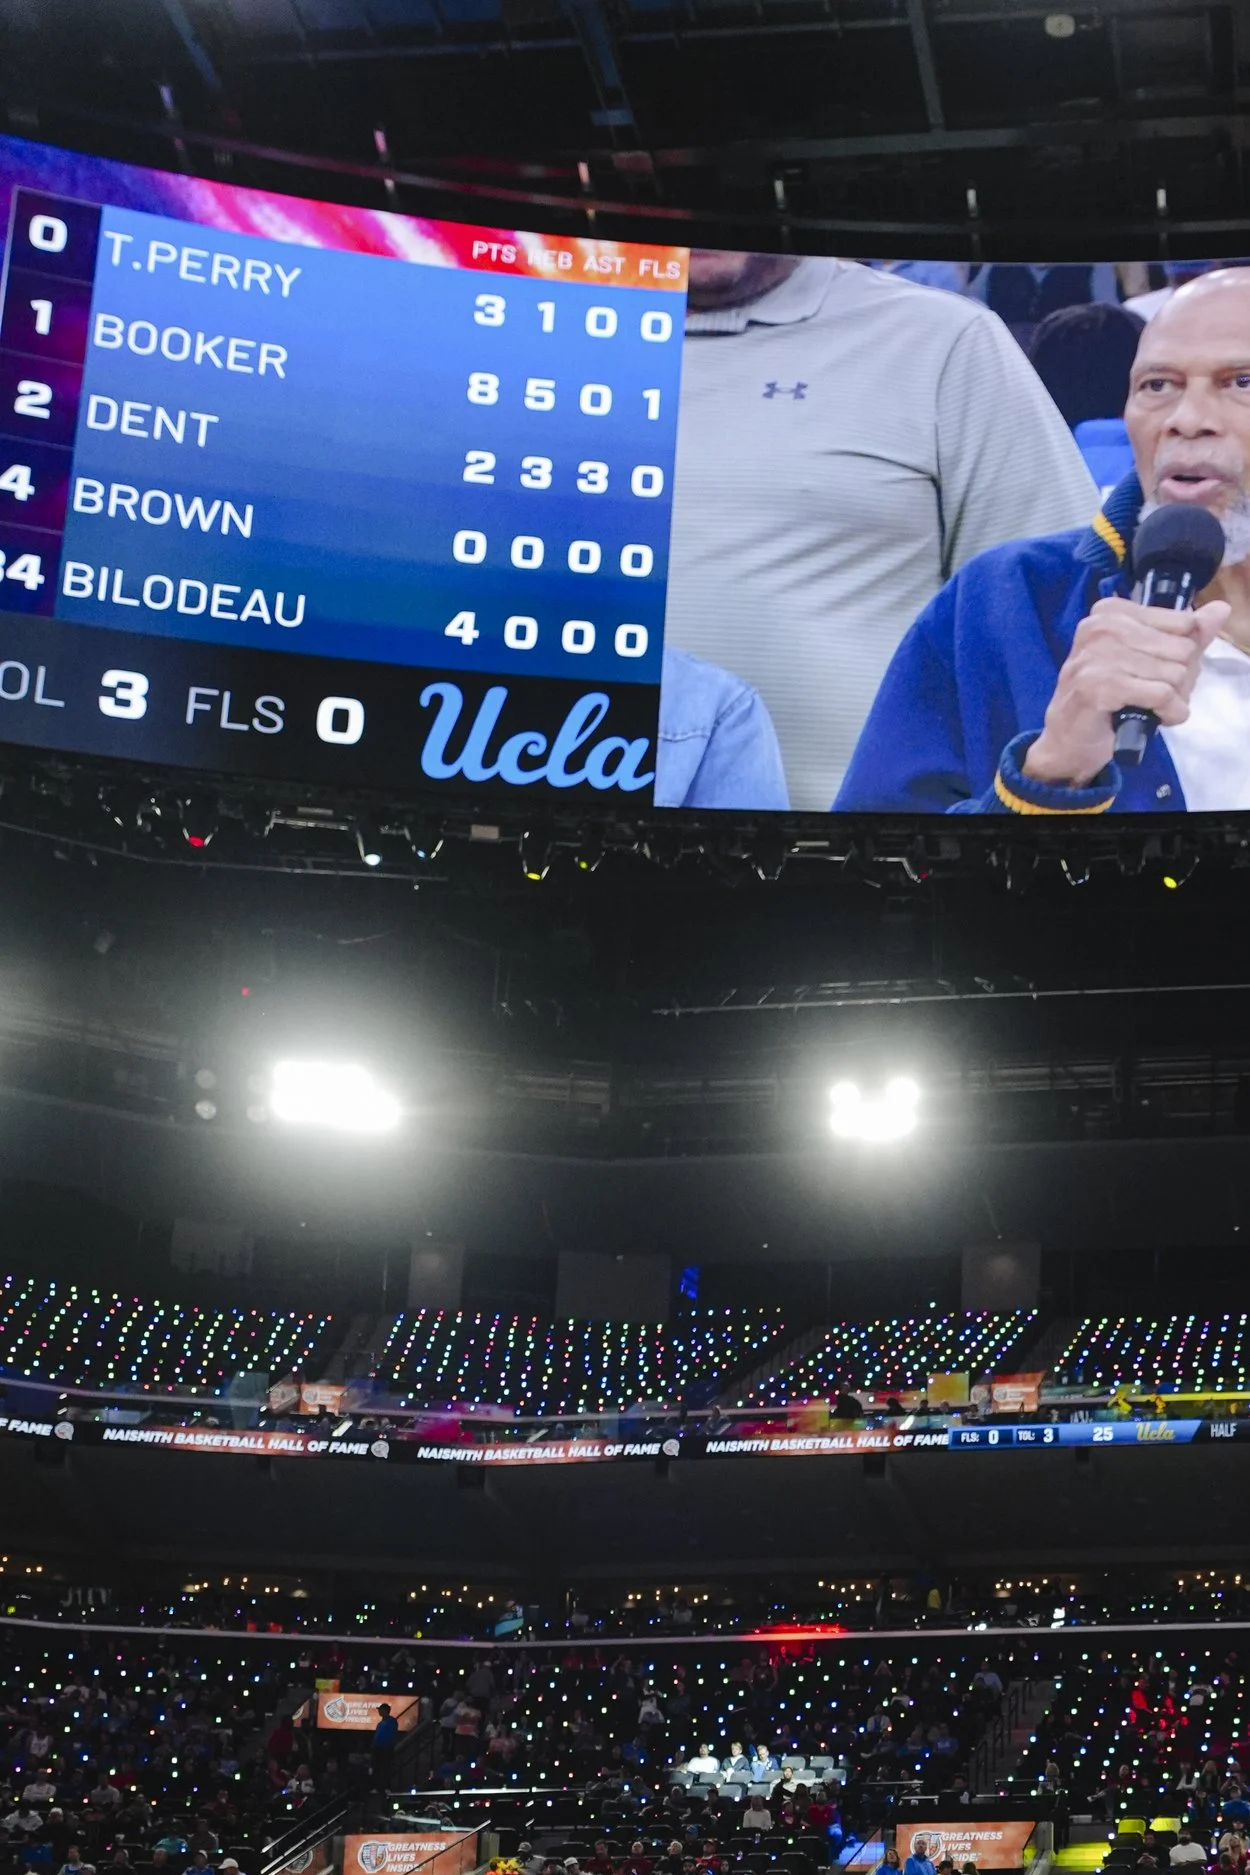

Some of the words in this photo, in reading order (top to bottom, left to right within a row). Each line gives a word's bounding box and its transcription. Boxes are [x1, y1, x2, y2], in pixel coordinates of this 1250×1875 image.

[472, 241, 518, 265] PTS
[528, 248, 573, 270] REB
[583, 254, 626, 275] AST
[639, 259, 681, 280] FLS
[30, 216, 67, 251] 0
[108, 229, 300, 295] T.PERRY
[475, 295, 505, 325] 3
[539, 302, 554, 331] 1
[586, 307, 617, 336] 0
[642, 312, 671, 341] 0
[31, 300, 51, 334] 1
[95, 314, 286, 376] BOOKER
[468, 373, 498, 403] 8
[525, 379, 554, 409] 5
[580, 384, 611, 414] 0
[644, 390, 659, 419] 1
[15, 381, 52, 418] 2
[88, 396, 217, 445] DENT
[464, 451, 495, 483] 2
[521, 457, 551, 487] 3
[578, 462, 608, 492] 3
[632, 466, 662, 496] 0
[0, 465, 34, 500] 4
[74, 478, 252, 536] BROWN
[454, 531, 486, 562] 0
[512, 537, 543, 568] 0
[569, 541, 600, 572] 0
[621, 545, 652, 576] 0
[64, 562, 304, 626] BILODEAU
[445, 612, 478, 644] 4
[505, 617, 537, 648] 0
[563, 621, 594, 653] 0
[616, 625, 647, 656] 0
[99, 670, 148, 719] 3
[186, 687, 284, 733] FLS
[317, 697, 364, 744] 0
[419, 681, 656, 792] Ucla
[8, 1420, 52, 1436] FAME
[988, 1430, 999, 1444] 0
[1043, 1428, 1054, 1442] 3
[1093, 1427, 1113, 1442] 25
[1210, 1423, 1237, 1438] HALF
[103, 1428, 171, 1445] NAISMITH
[174, 1432, 265, 1449] BASKETBALL
[267, 1438, 304, 1452] HALL
[308, 1440, 328, 1452] OF
[329, 1441, 369, 1455] FAME
[417, 1446, 483, 1461] NAISMITH
[484, 1446, 566, 1461] BASKETBALL
[568, 1445, 601, 1458] HALL
[604, 1444, 622, 1457] OF
[624, 1442, 661, 1456] FAME
[706, 1440, 768, 1453] NAISMITH
[770, 1437, 853, 1451] BASKETBALL
[856, 1434, 891, 1448] HALL
[893, 1433, 912, 1446] OF
[912, 1433, 949, 1446] FAME
[388, 1842, 446, 1851] GREATNESS
[942, 1832, 1003, 1841] GREATNESS
[942, 1842, 971, 1851] LIVES
[387, 1853, 416, 1862] LIVES
